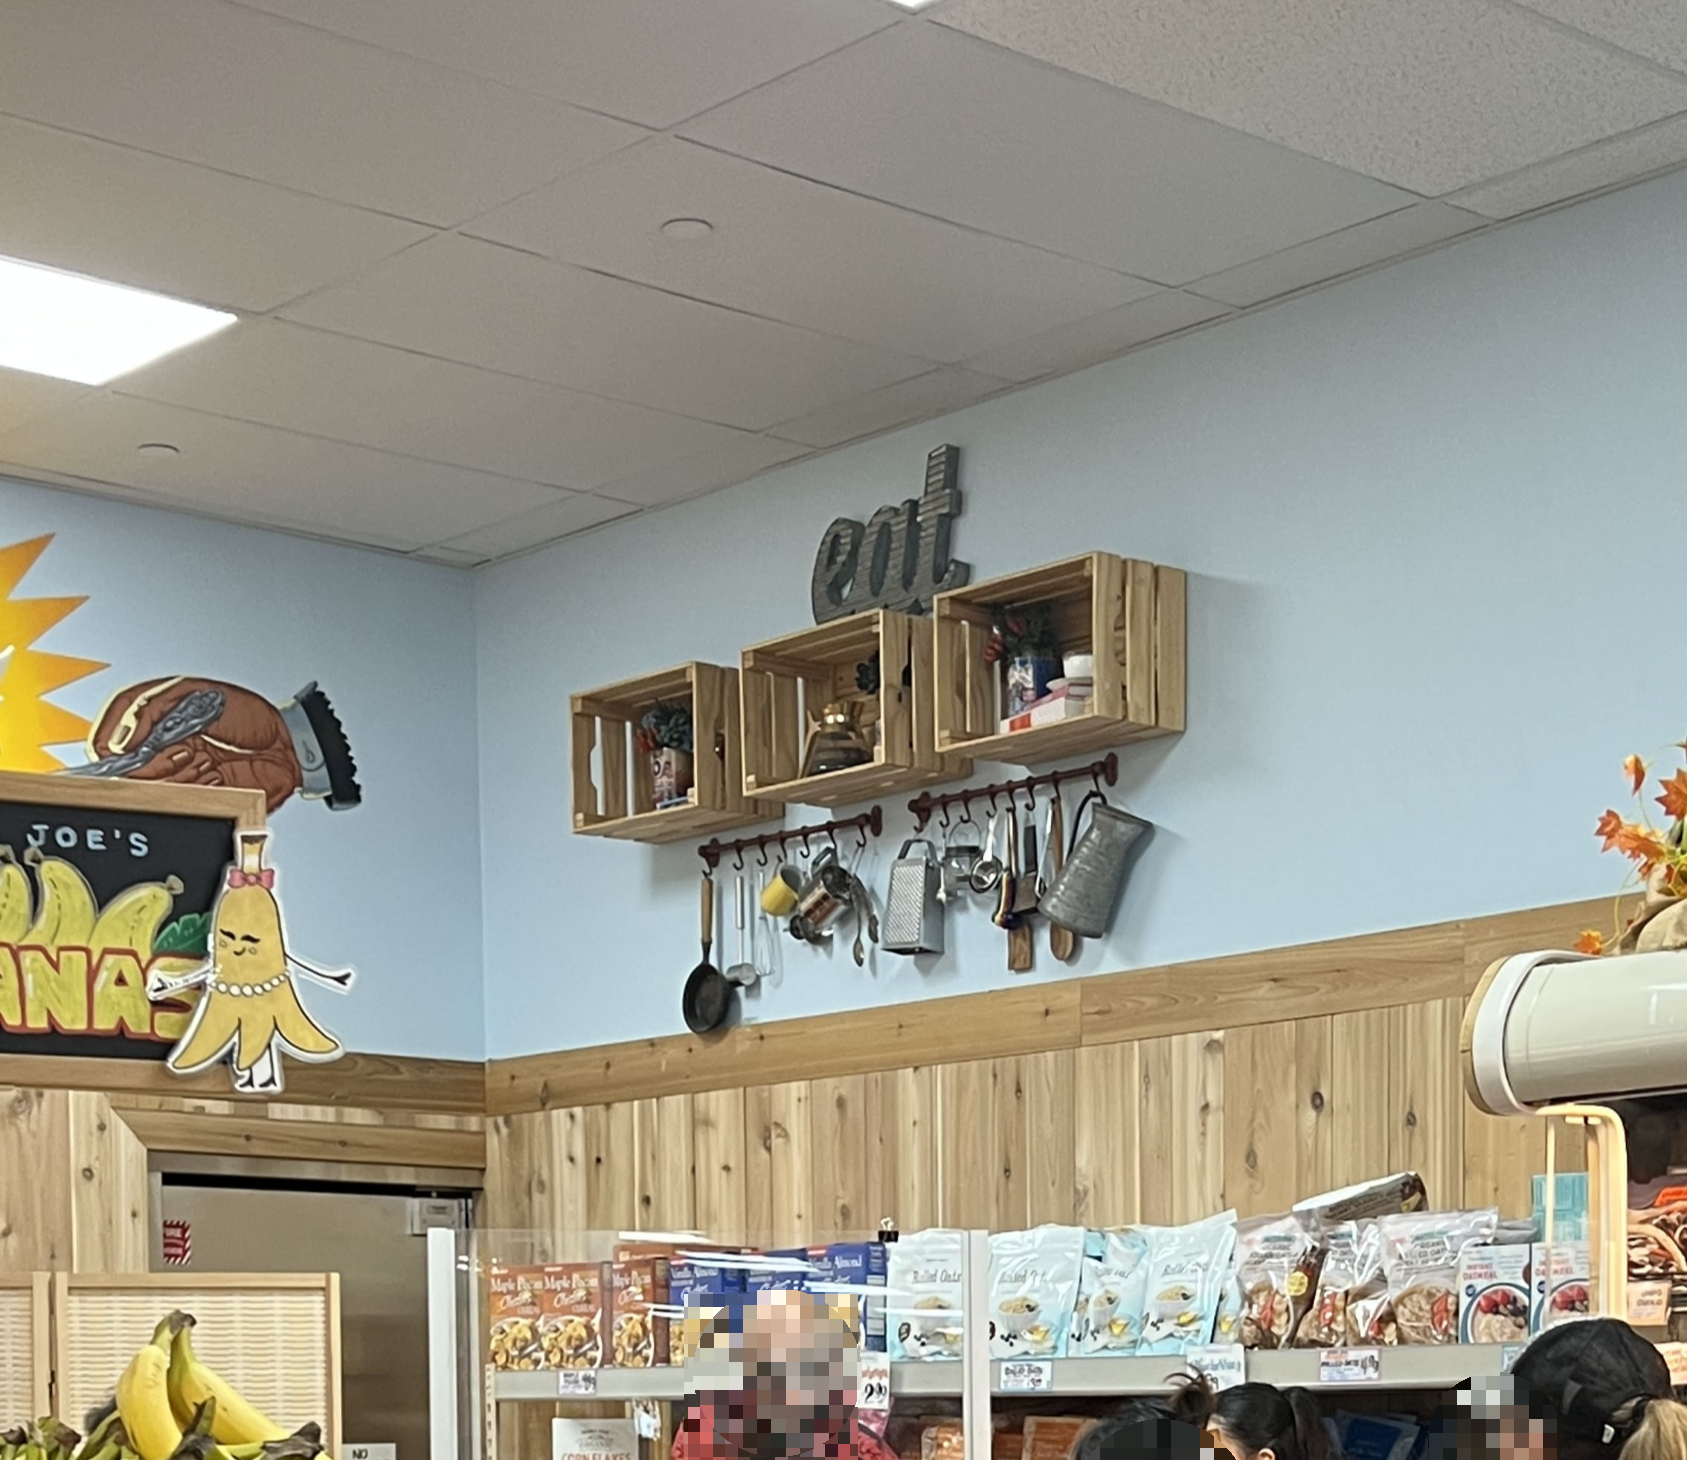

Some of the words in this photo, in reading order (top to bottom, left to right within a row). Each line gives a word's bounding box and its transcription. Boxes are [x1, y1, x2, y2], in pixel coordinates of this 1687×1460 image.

[811, 443, 970, 625] eat
[26, 823, 149, 857] JOE'S
[352, 1448, 369, 1460] NO
